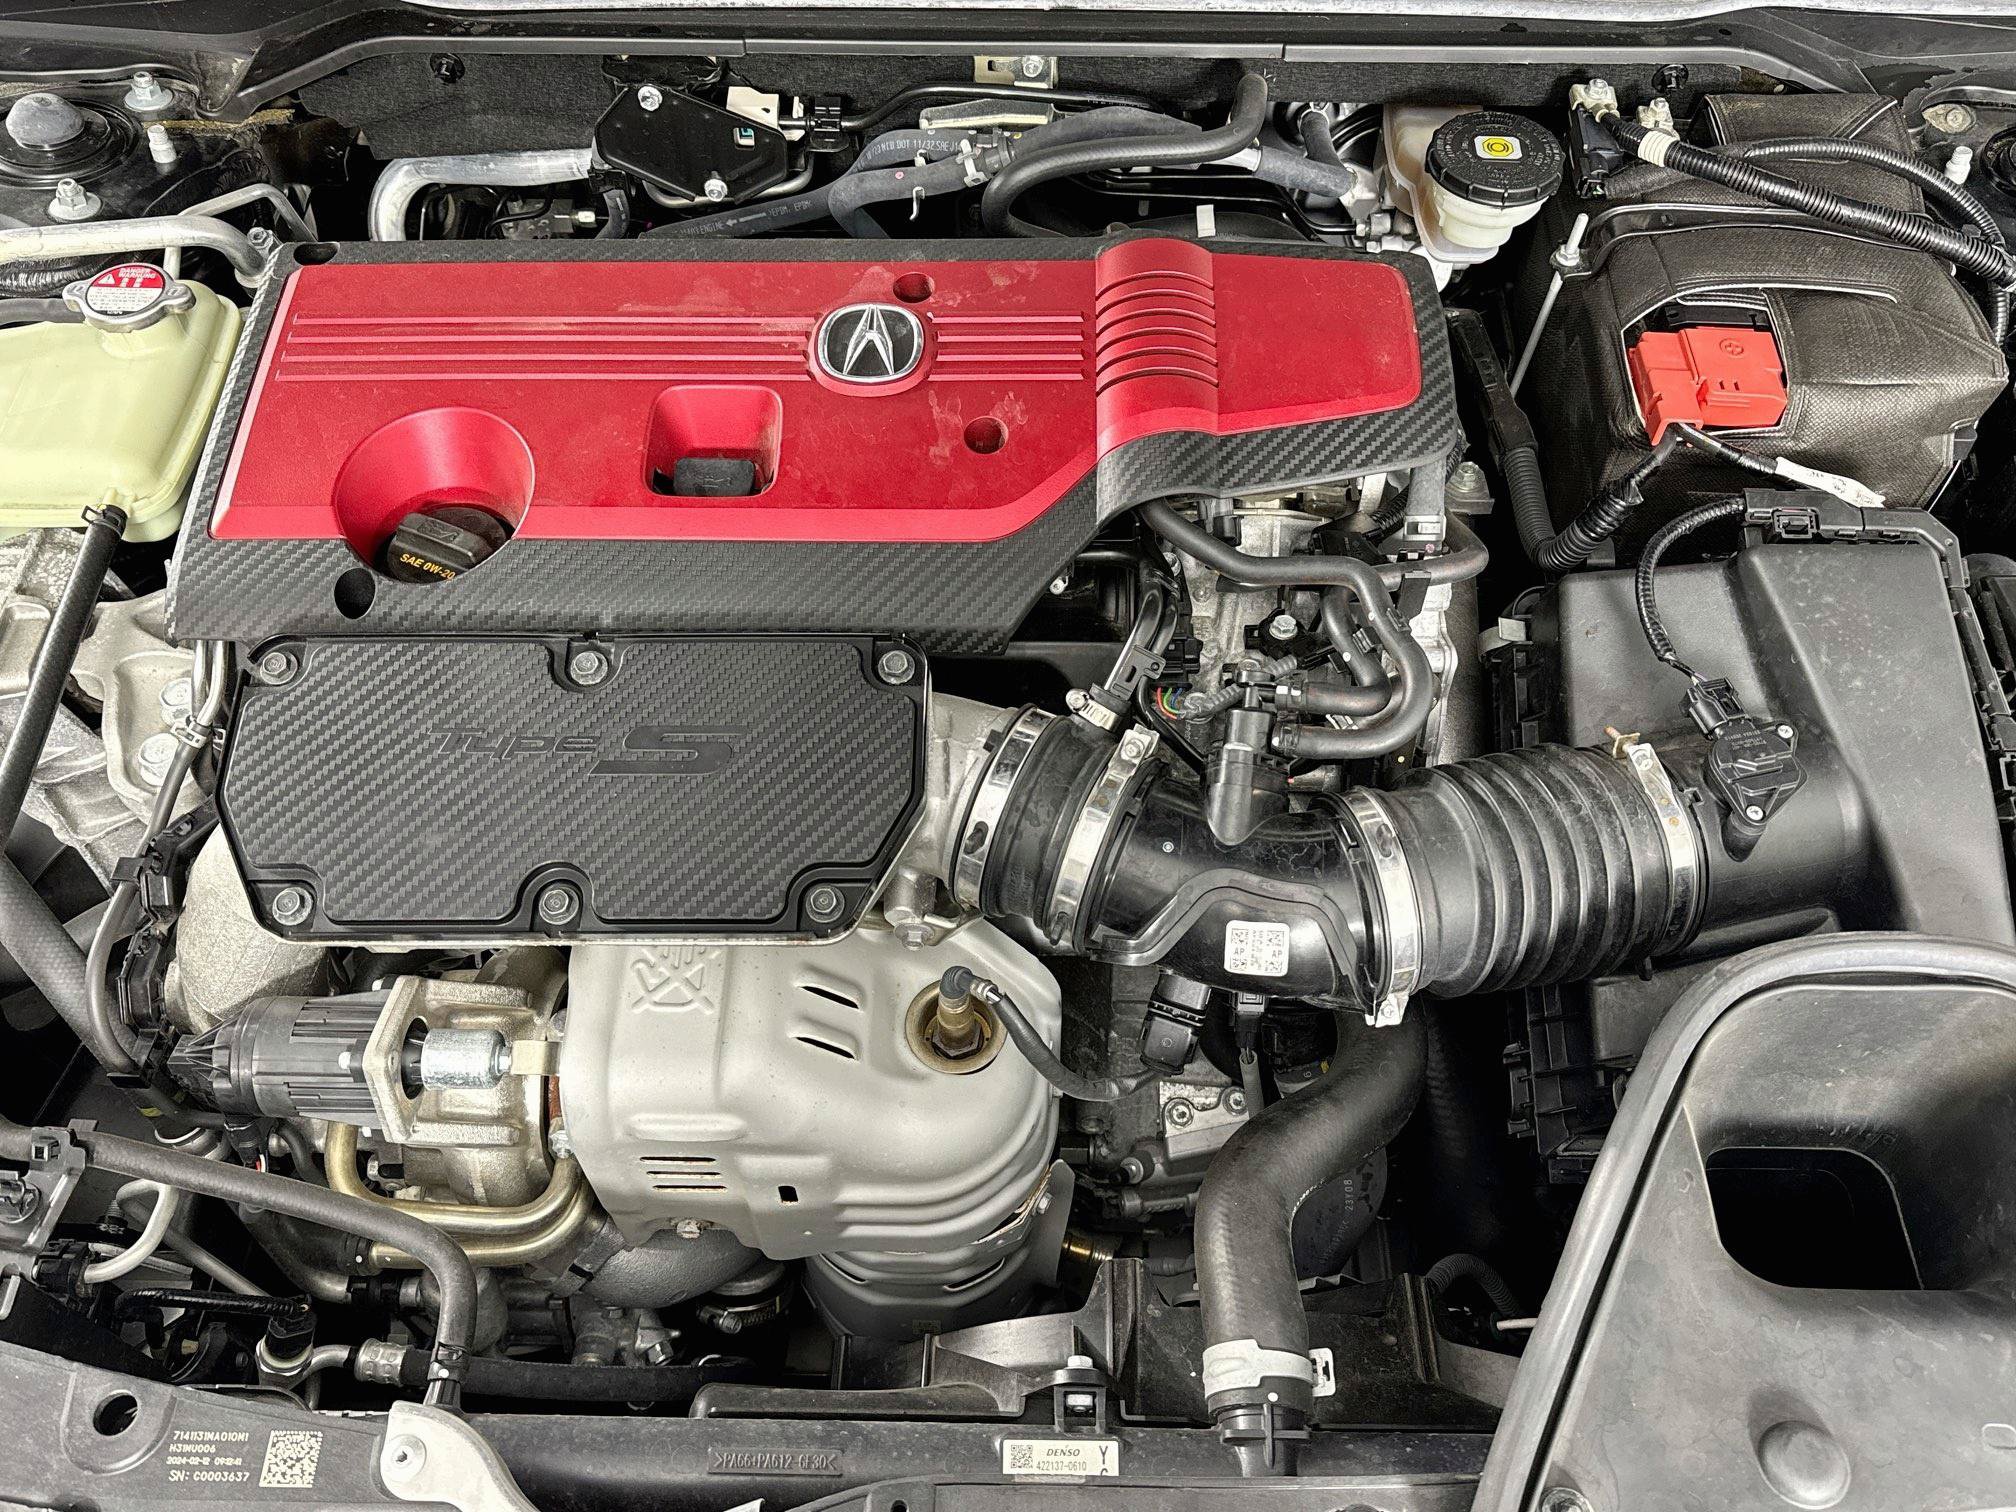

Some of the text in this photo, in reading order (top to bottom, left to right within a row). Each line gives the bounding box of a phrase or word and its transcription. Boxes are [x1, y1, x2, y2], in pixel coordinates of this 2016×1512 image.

[400, 553, 456, 580] SAE 0W-20
[588, 725, 746, 776] S
[1046, 1445, 1109, 1465] DENSO Y
[168, 1469, 190, 1482] SN:
